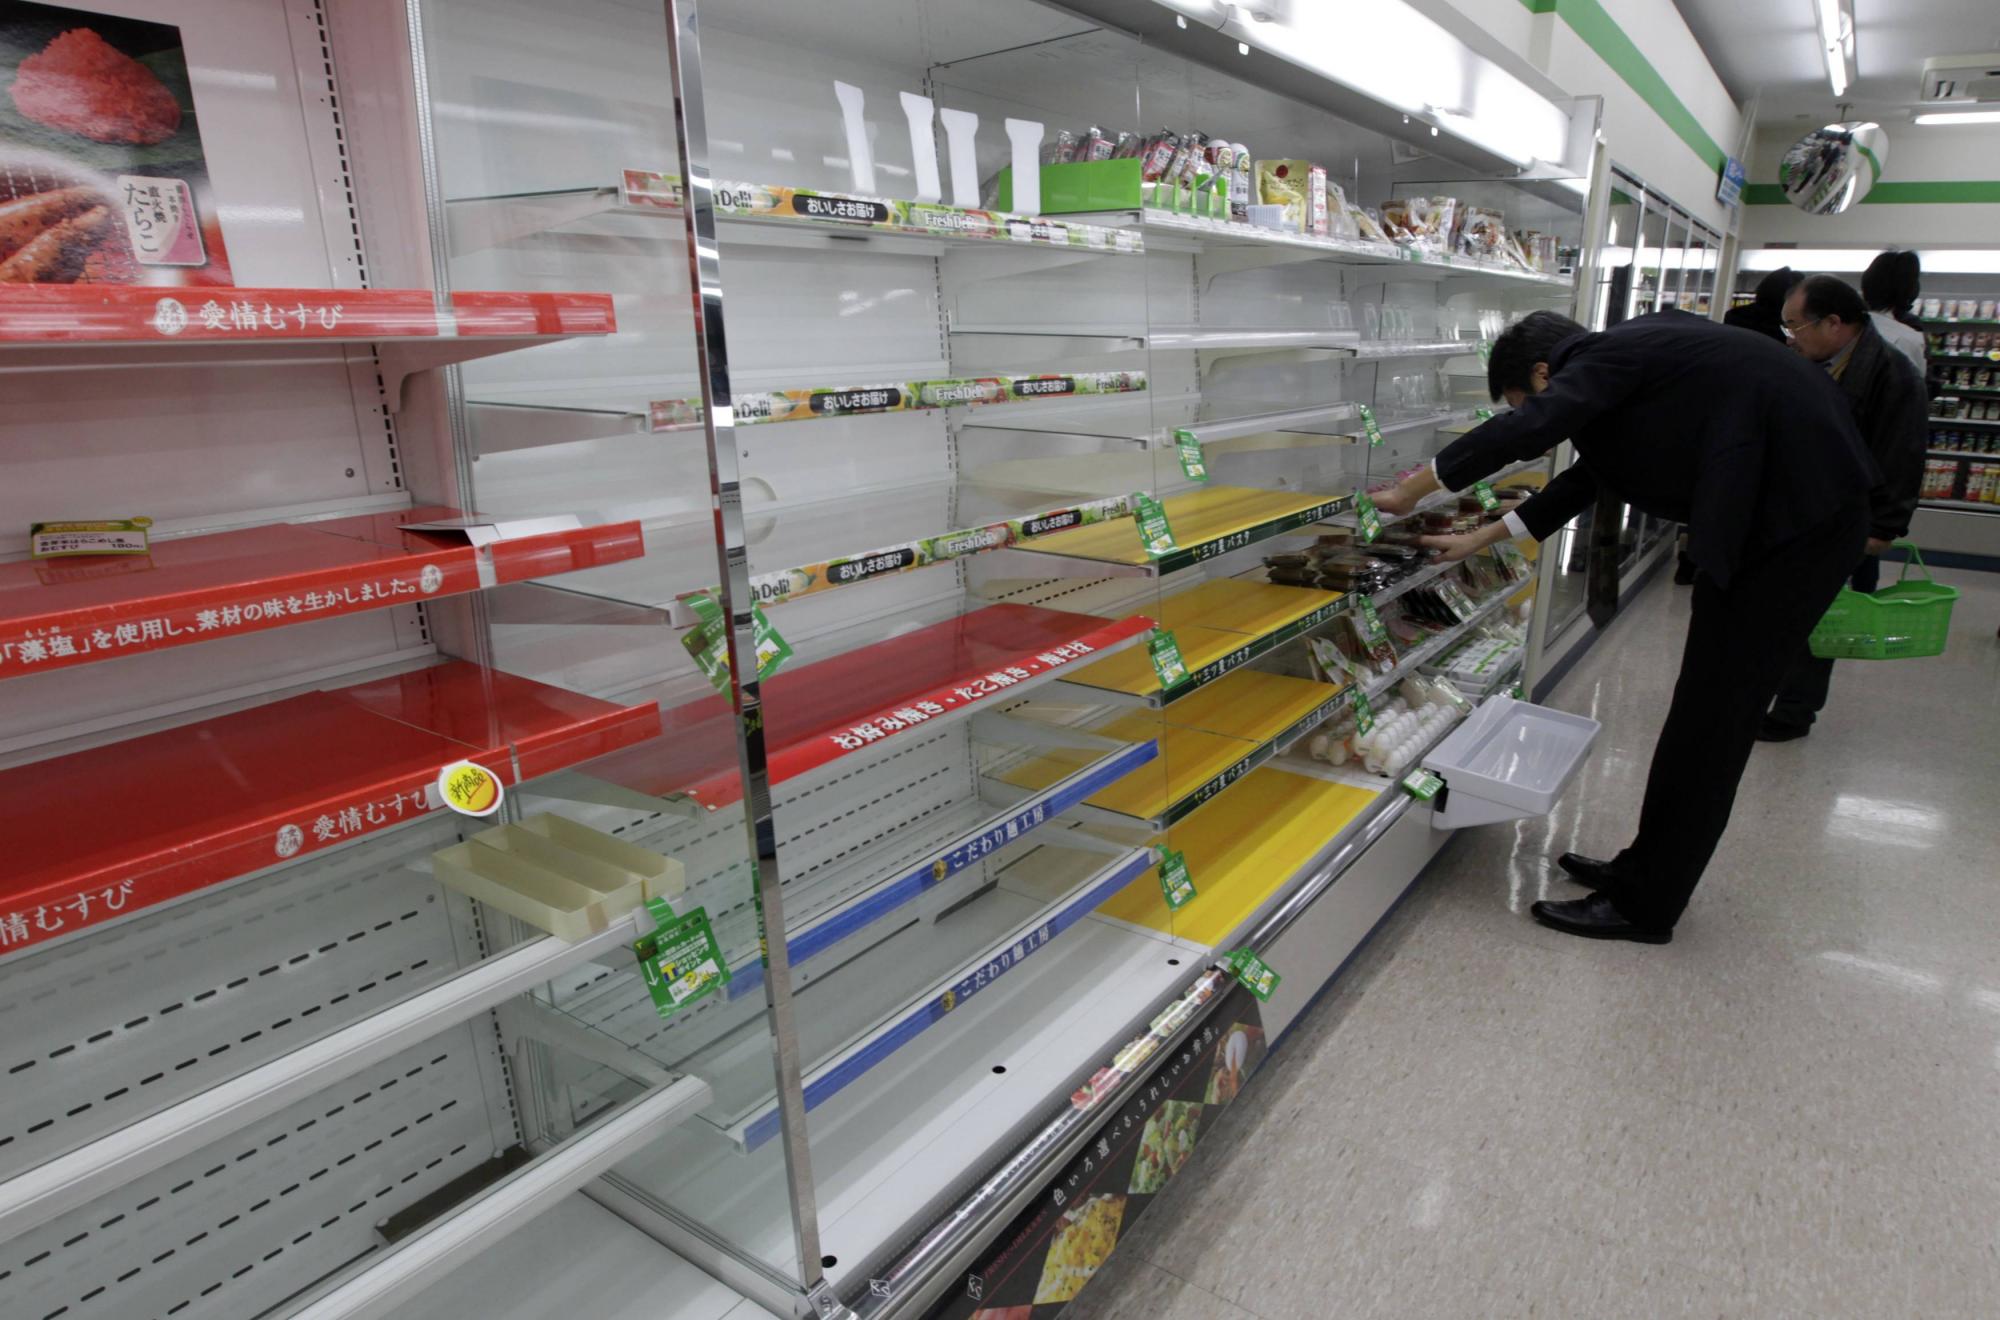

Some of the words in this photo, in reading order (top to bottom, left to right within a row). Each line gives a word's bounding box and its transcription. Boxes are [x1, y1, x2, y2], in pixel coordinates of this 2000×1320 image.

[124, 183, 159, 252] たらこ
[807, 198, 875, 219] おいしさお届け
[200, 299, 344, 330] 愛情むすび
[823, 392, 888, 410] おいしさお届け
[1201, 531, 1251, 560] 三ツ星パスタ
[839, 553, 903, 580] おいしさお届け
[0, 577, 416, 664] 「藻塩」を使用し、素材の味を生かしました。
[1202, 647, 1250, 683] 三ツ星パスタ
[830, 641, 1095, 750] お好み焼き・たこ焼き・焼そば
[449, 768, 486, 801] 新商品
